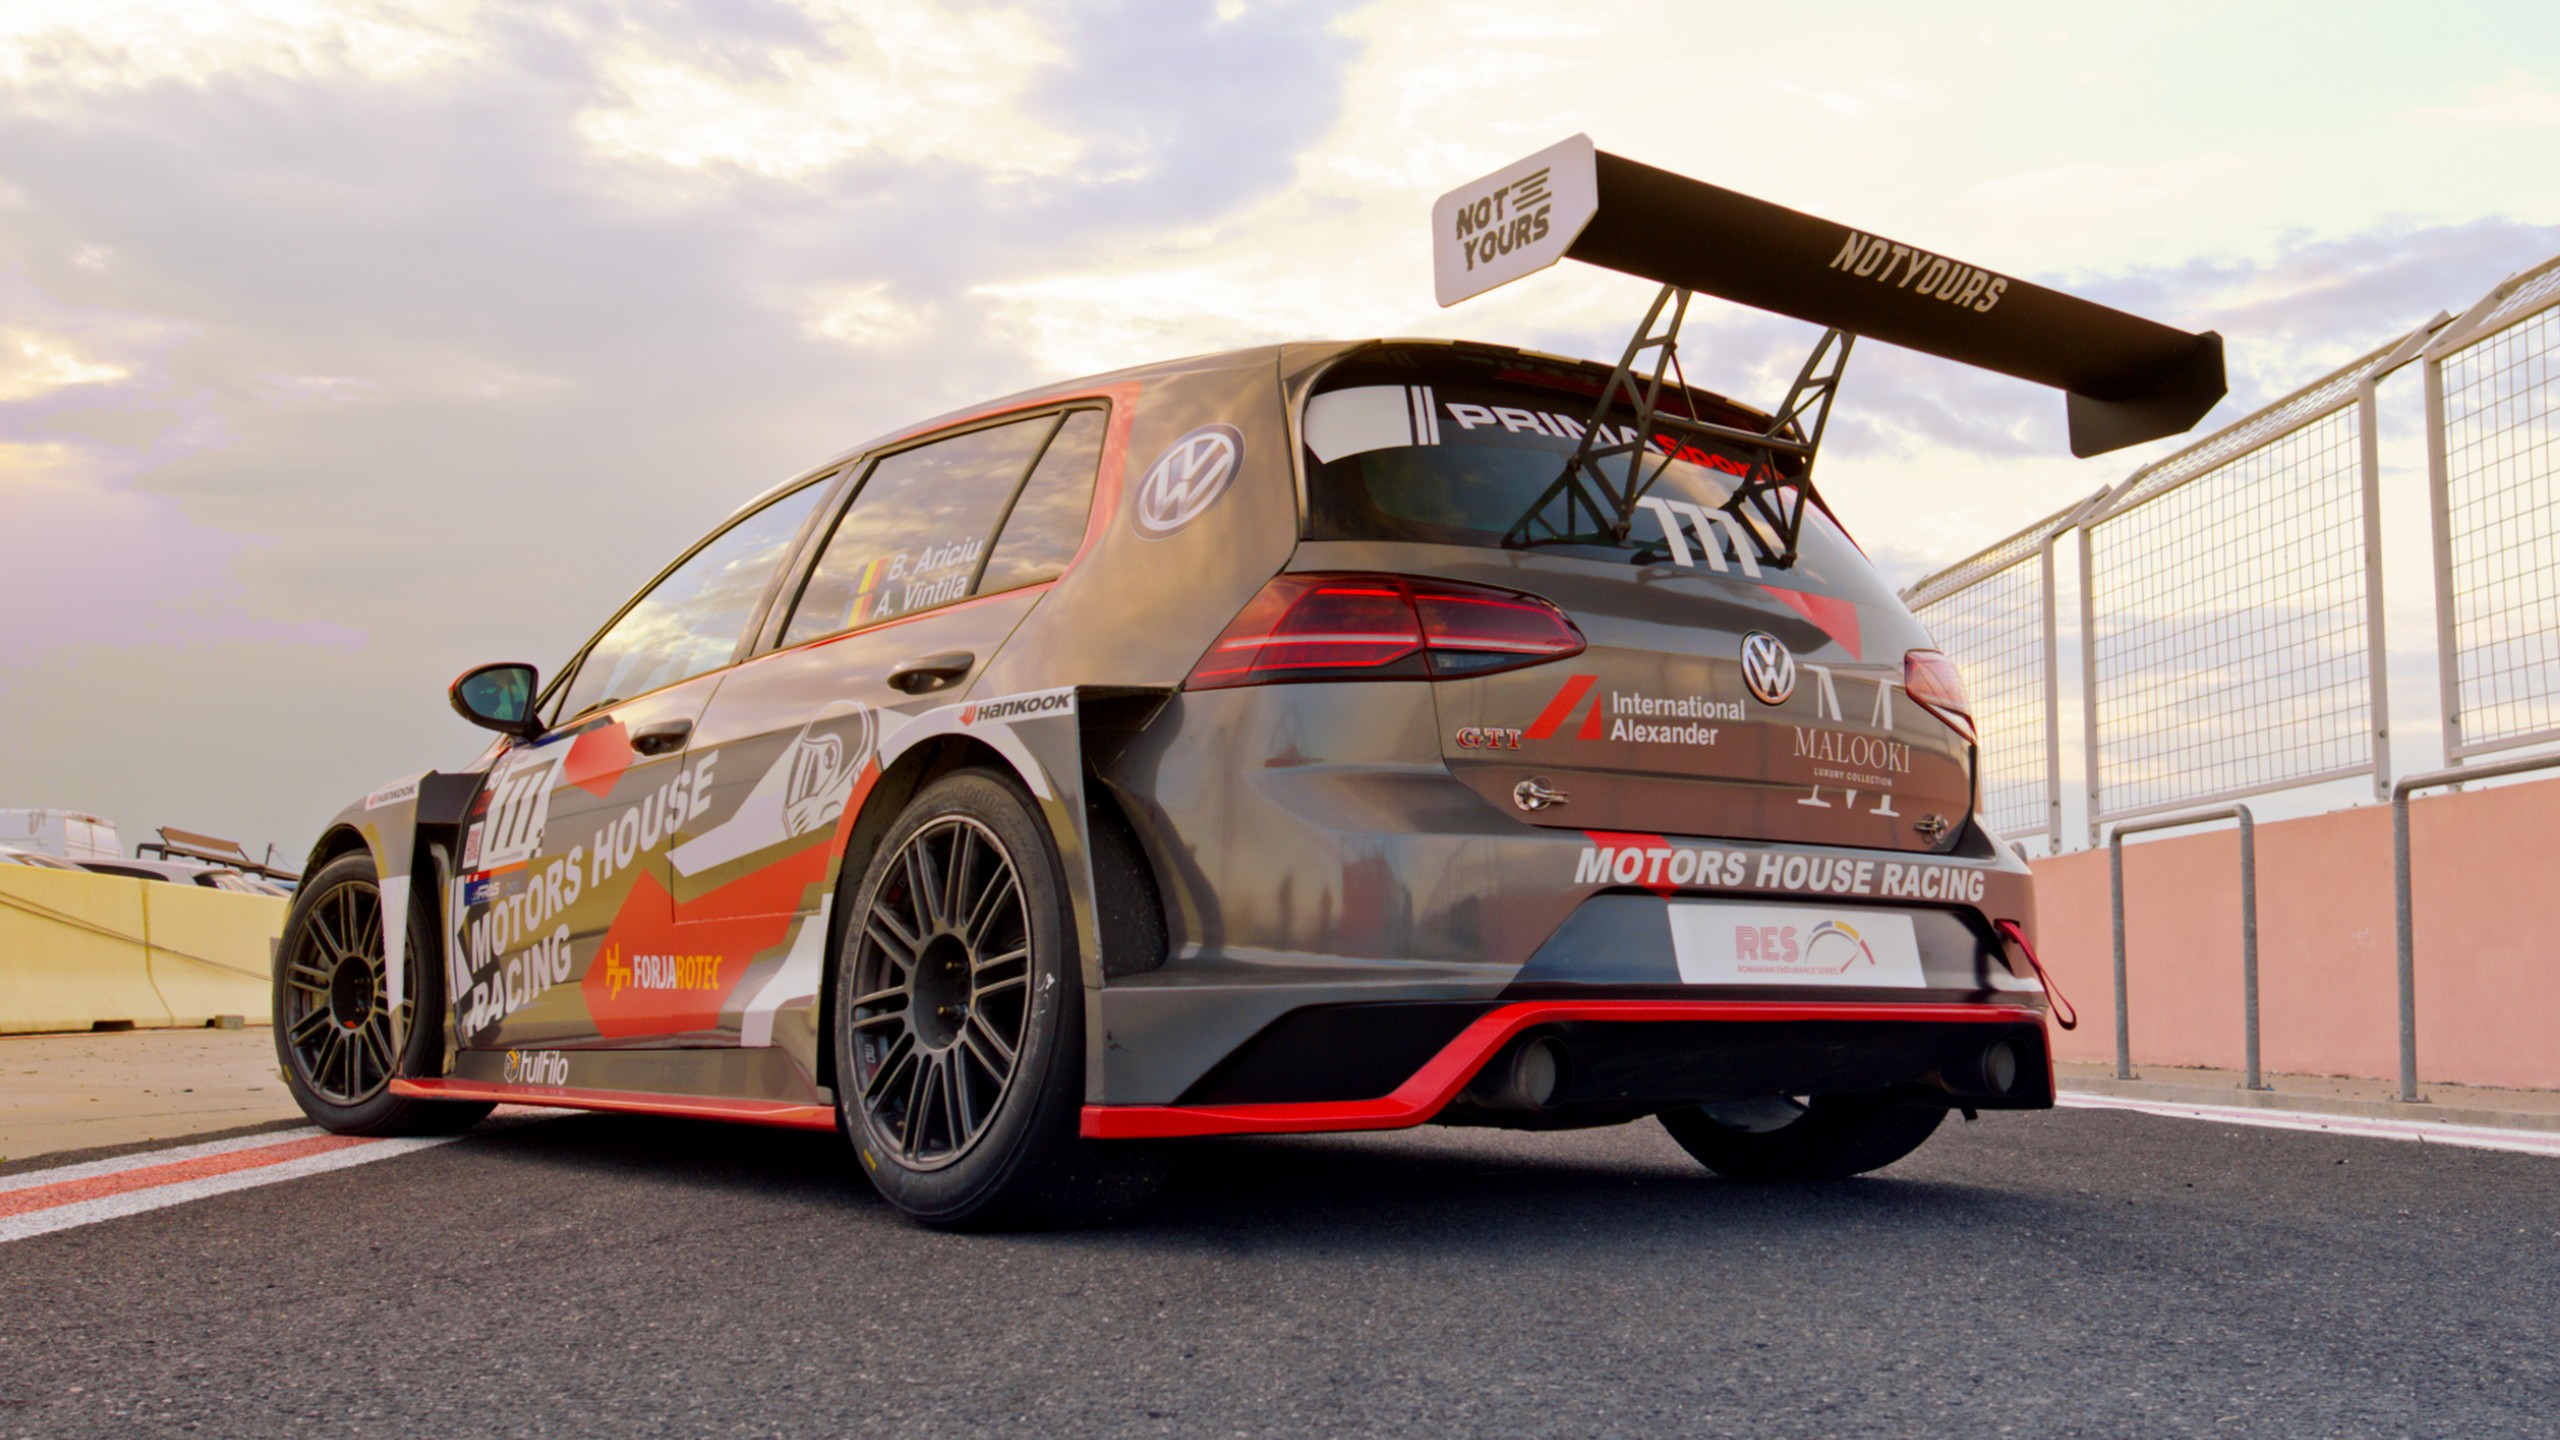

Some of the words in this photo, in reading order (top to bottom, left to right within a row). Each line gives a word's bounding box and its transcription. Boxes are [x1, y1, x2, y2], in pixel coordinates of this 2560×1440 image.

[1456, 186, 1509, 241] NOT
[1464, 203, 1551, 272] YOURS
[1829, 231, 2008, 313] NOTYOURS
[886, 552, 908, 582] B.
[913, 536, 984, 575] Ariciu
[872, 590, 894, 619] A.
[1612, 690, 1745, 721] International
[1456, 727, 1522, 750] GTI
[1609, 718, 1719, 746] Alexander
[1792, 725, 1911, 774] MALOOKI
[471, 844, 583, 975] MOTORS
[591, 748, 720, 888] HOUSE
[1573, 847, 1747, 888] MOTORS
[1755, 853, 1874, 893] HOUSE
[1880, 861, 1986, 902] RACING
[1735, 926, 1800, 963] RES
[466, 923, 573, 1039] RACING
[633, 954, 723, 991] FORJAROTEC
